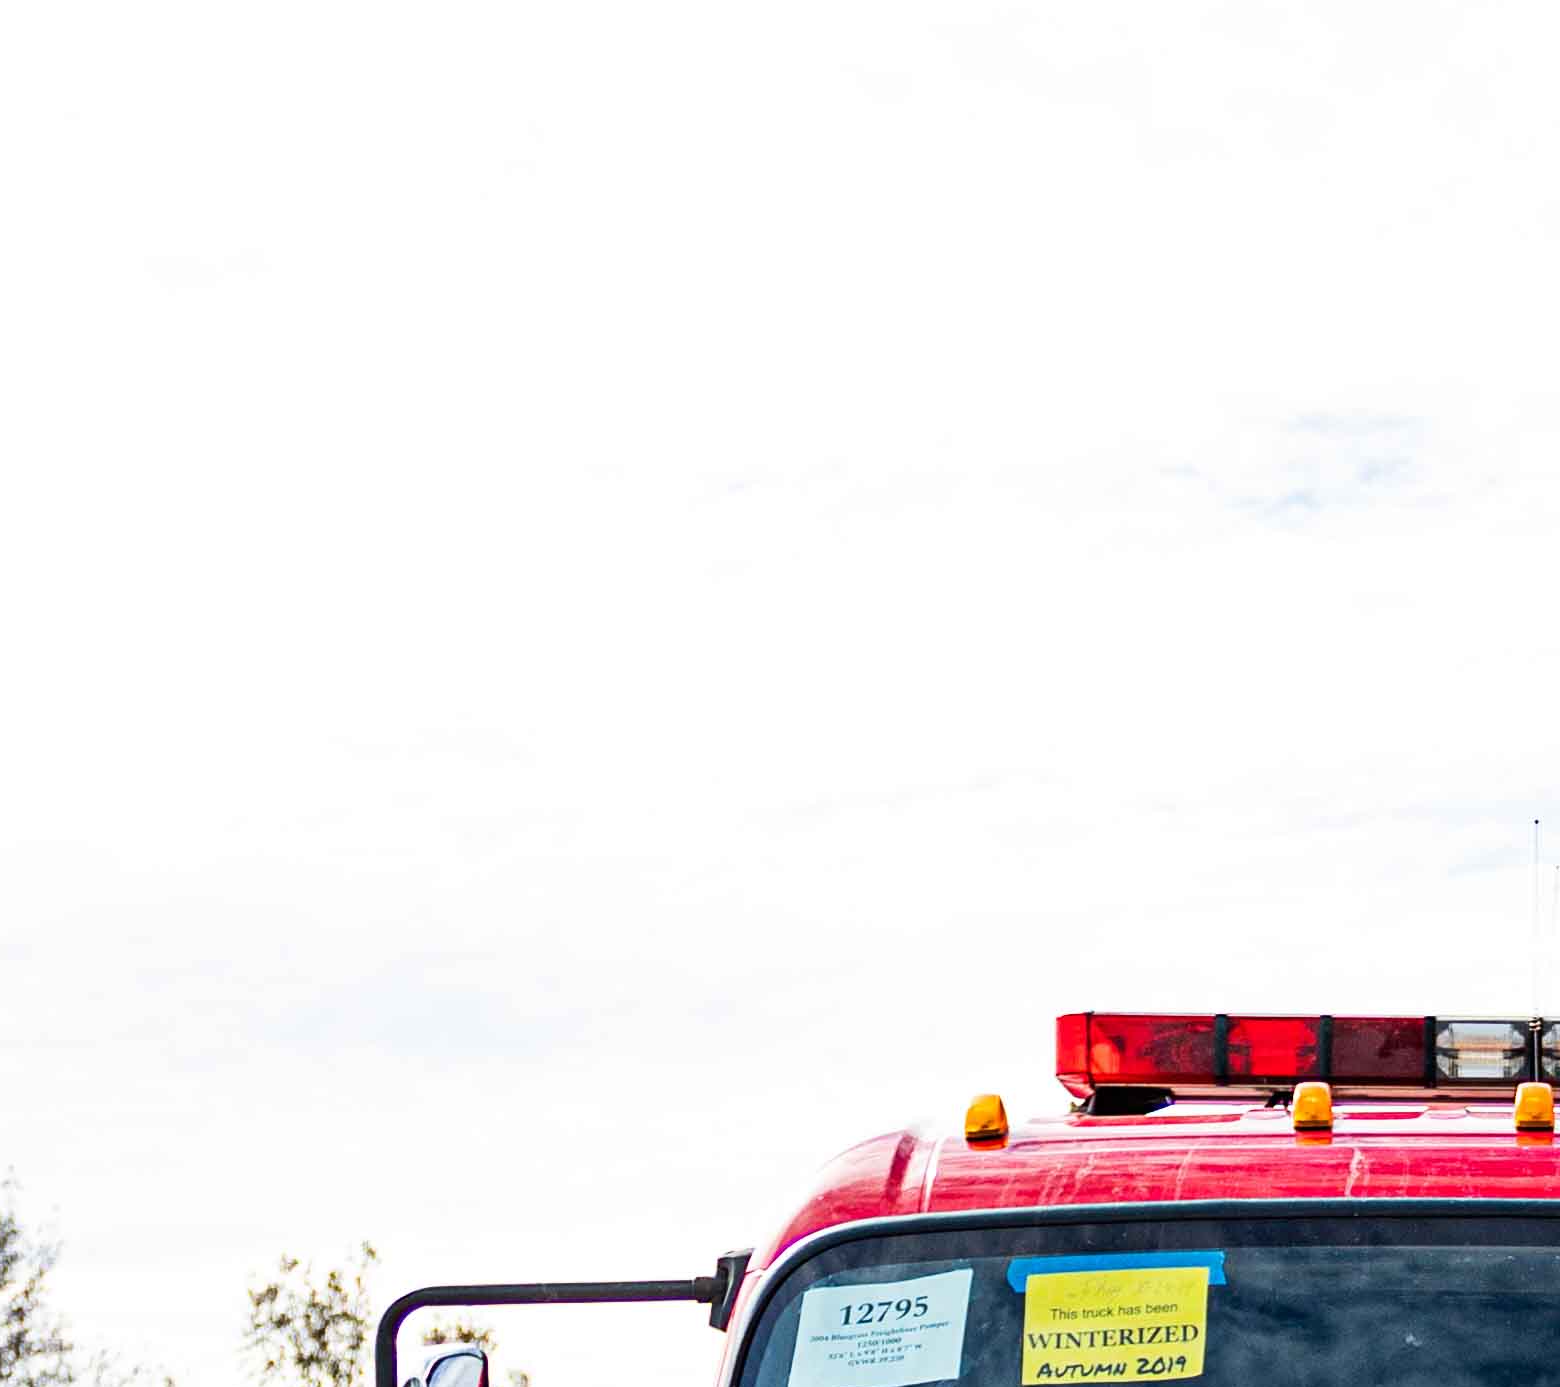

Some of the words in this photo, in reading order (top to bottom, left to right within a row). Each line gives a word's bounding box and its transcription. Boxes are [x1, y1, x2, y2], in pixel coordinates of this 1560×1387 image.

[840, 1296, 928, 1326] 12795
[1049, 1308, 1078, 1321] This
[1082, 1306, 1114, 1319] truck
[1118, 1304, 1141, 1316] has
[1145, 1303, 1178, 1314] been
[1027, 1324, 1199, 1350] WINTERIZED
[1037, 1361, 1127, 1379] AUTUMN
[1136, 1355, 1186, 1375] 2019
